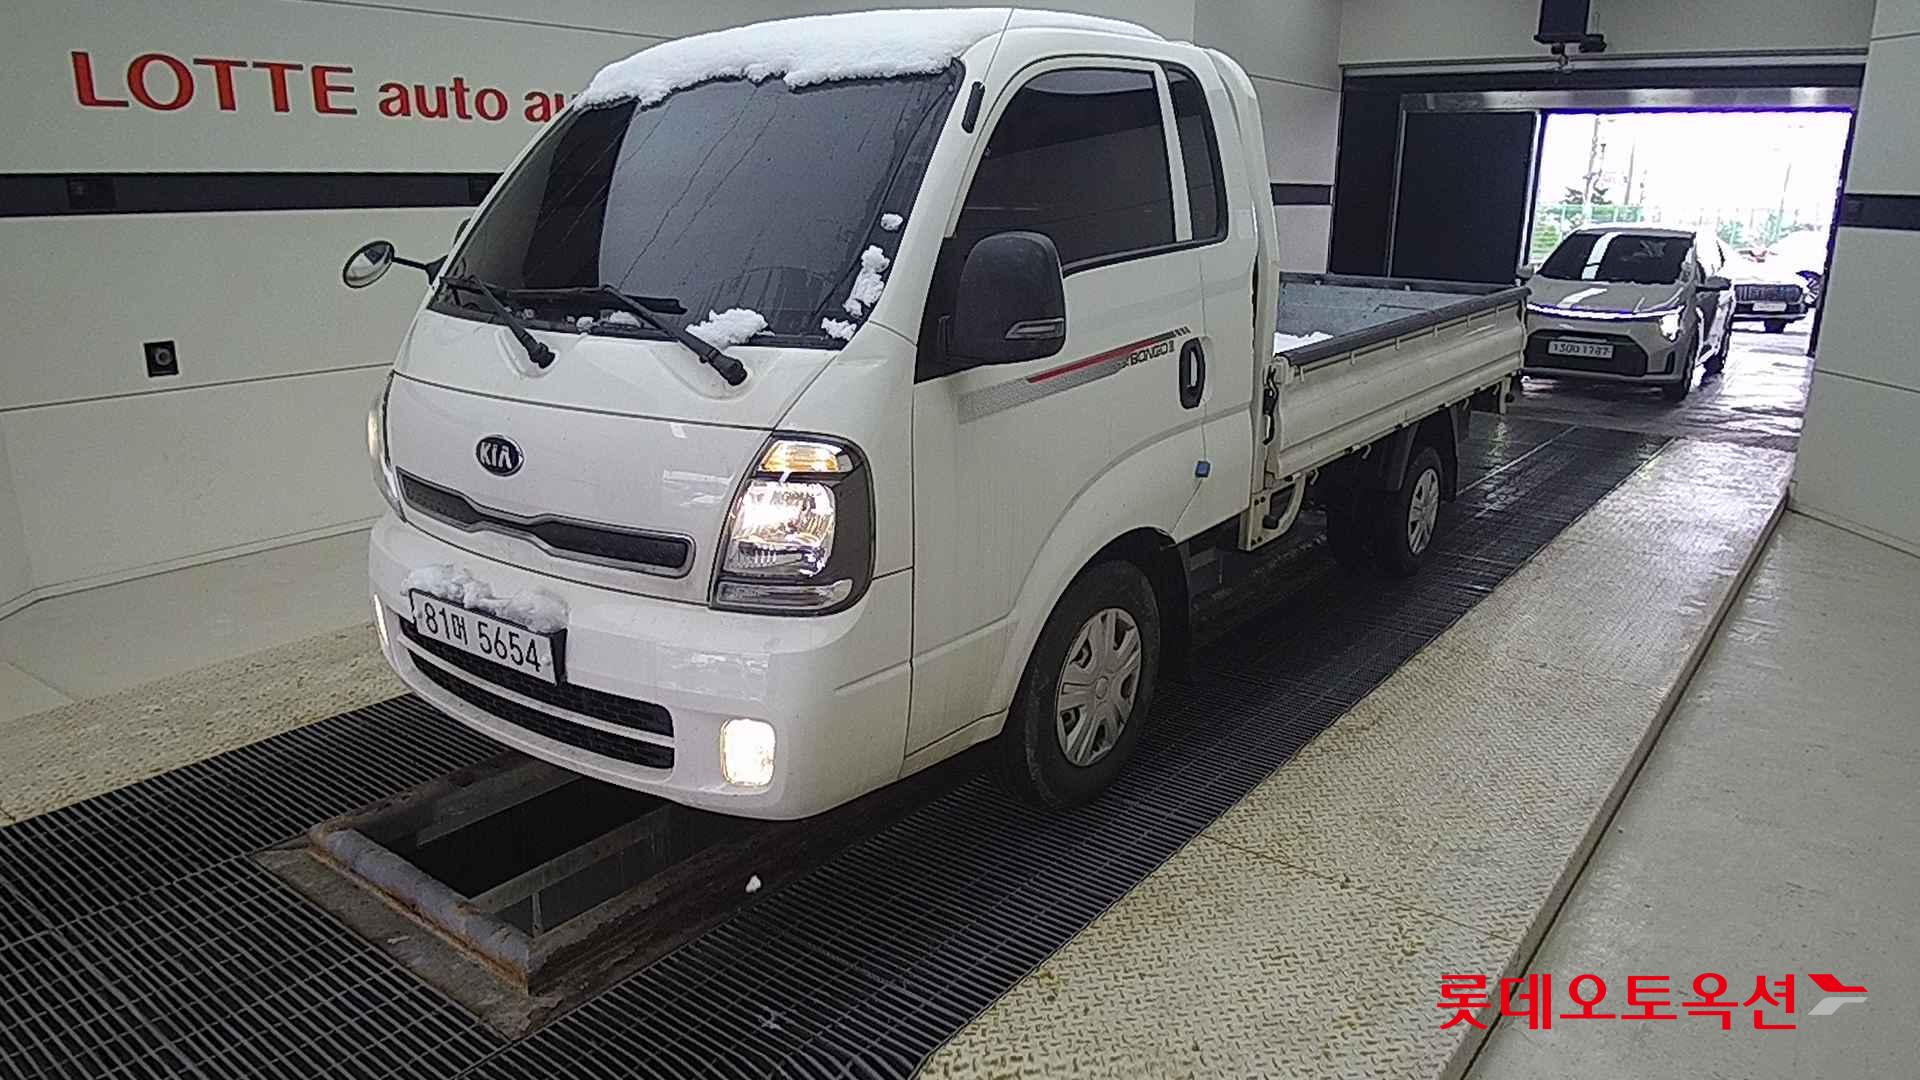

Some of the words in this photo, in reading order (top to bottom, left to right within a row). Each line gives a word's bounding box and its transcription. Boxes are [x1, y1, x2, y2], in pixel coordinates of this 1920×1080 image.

[71, 51, 358, 115] LOTTE
[377, 77, 509, 122] auto
[1130, 342, 1168, 366] BONGO
[480, 441, 512, 469] KIA
[424, 602, 468, 645] 81머
[478, 621, 541, 672] 5654
